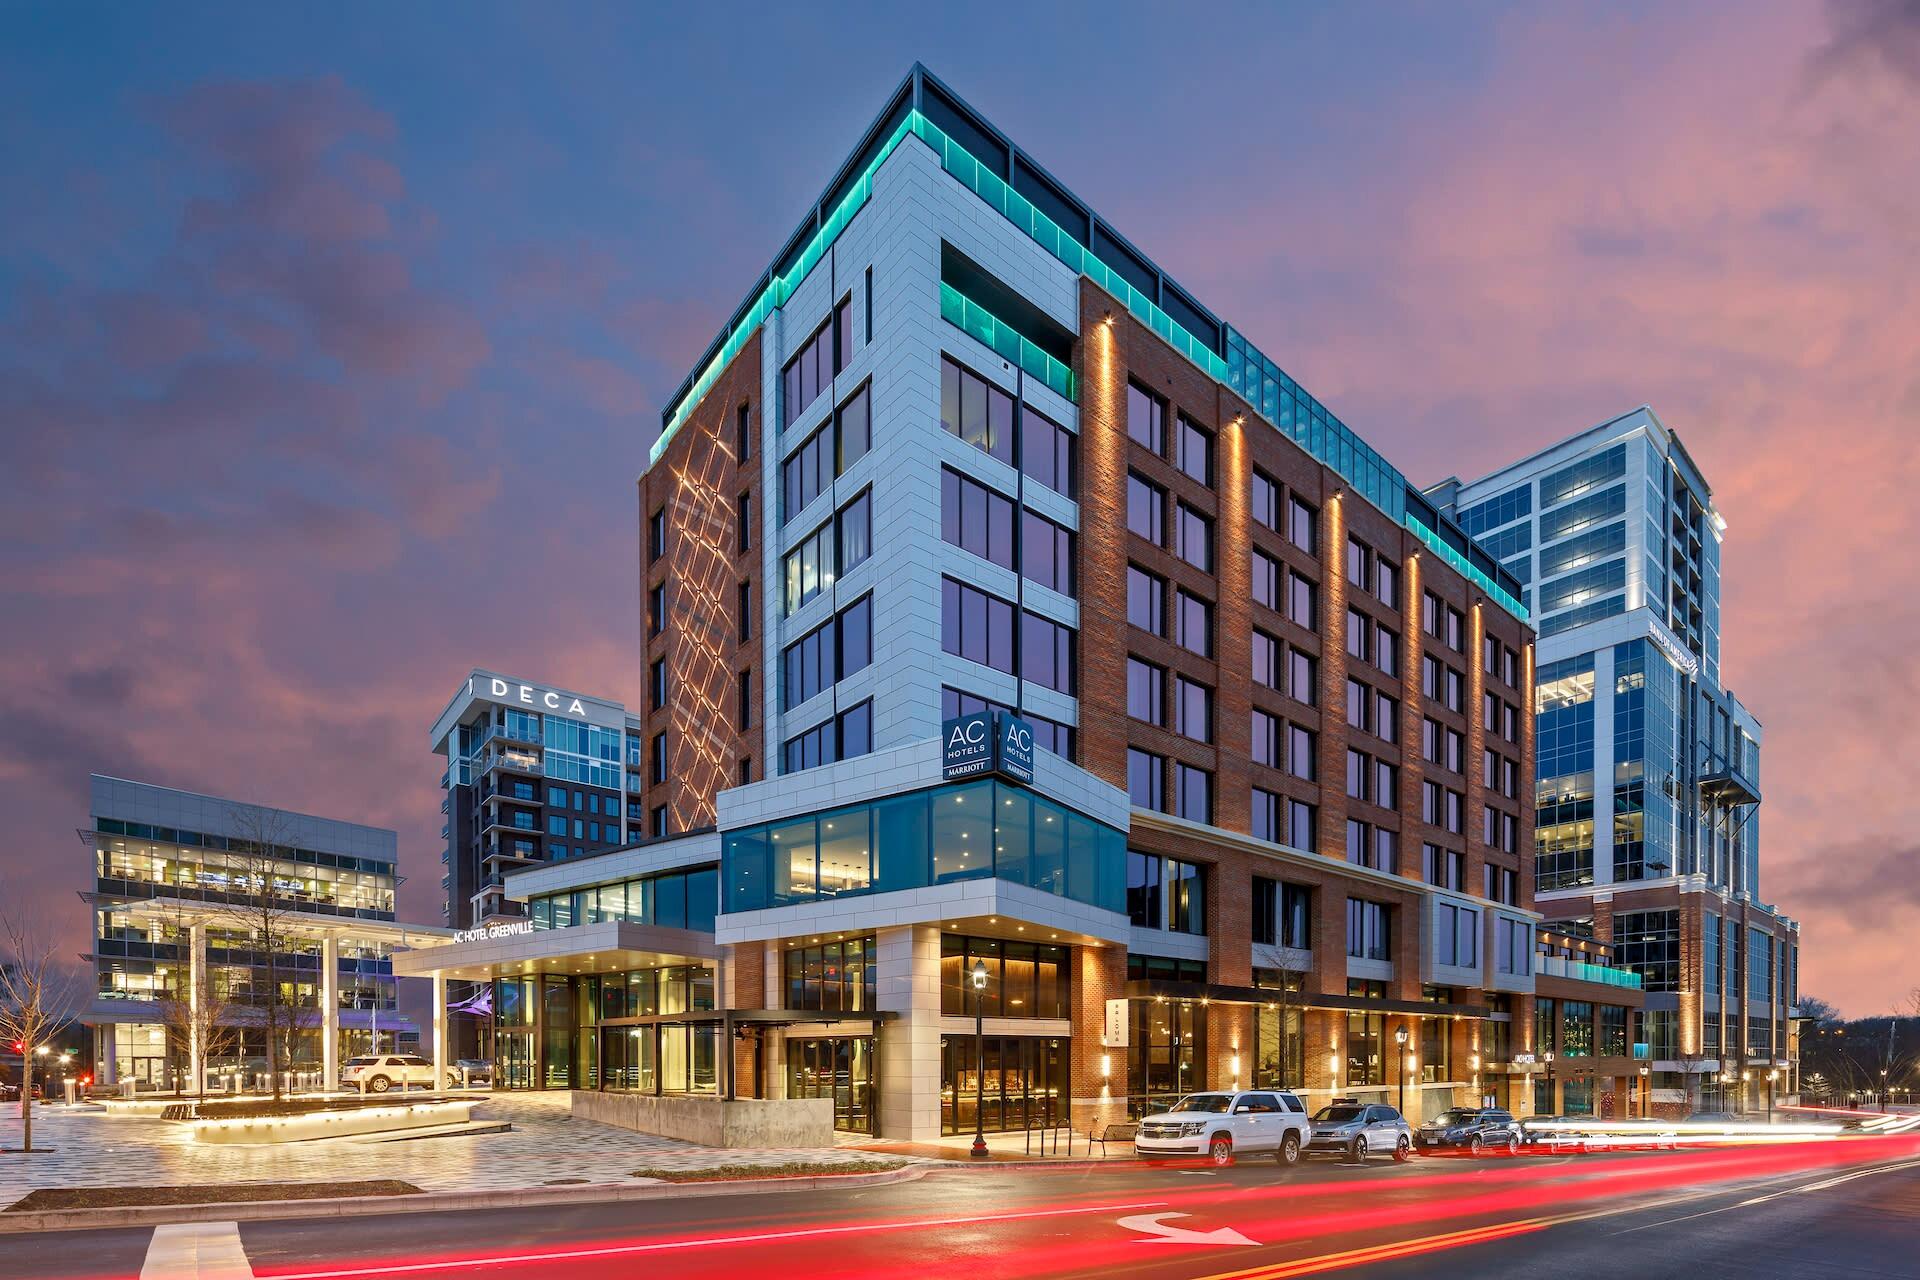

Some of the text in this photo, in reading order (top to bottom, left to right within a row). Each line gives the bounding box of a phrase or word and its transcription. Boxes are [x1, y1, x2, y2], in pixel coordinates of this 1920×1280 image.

[1649, 620, 1664, 646] BANK
[1670, 642, 1691, 669] AMERICA
[491, 678, 586, 716] DECA
[948, 720, 985, 749] AC
[1007, 723, 1031, 752] AC
[947, 744, 985, 760] HOTELS
[1006, 745, 1031, 764] HOTELS
[948, 761, 985, 777] MARRIOTT
[1007, 763, 1031, 780] MARRIOTT
[453, 920, 534, 945] AC HOTEL GREENVILLE
